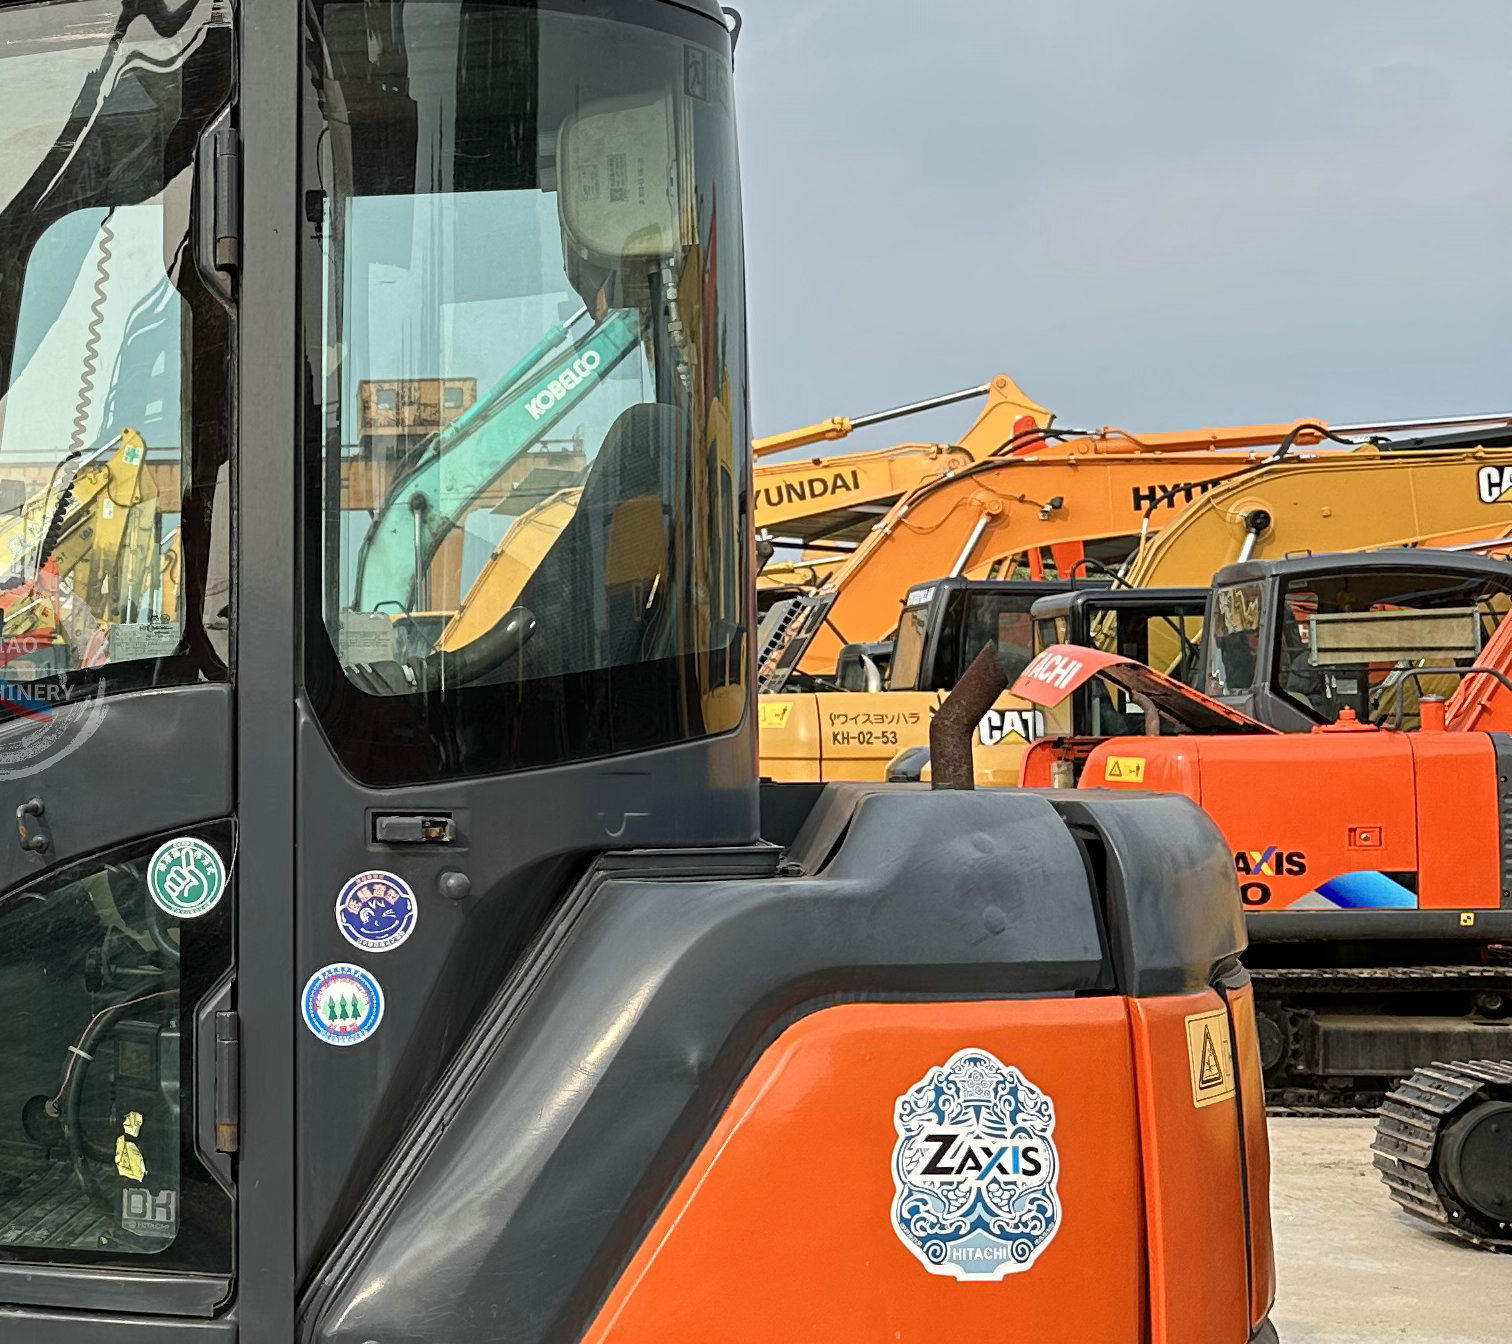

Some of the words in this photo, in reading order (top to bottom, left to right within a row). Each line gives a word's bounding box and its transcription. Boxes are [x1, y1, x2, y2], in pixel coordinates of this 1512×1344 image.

[524, 349, 601, 421] KOBELCO
[832, 730, 898, 745] KH-02-53
[919, 1133, 1043, 1181] ZAXIS
[951, 1246, 1008, 1262] HITACHI
